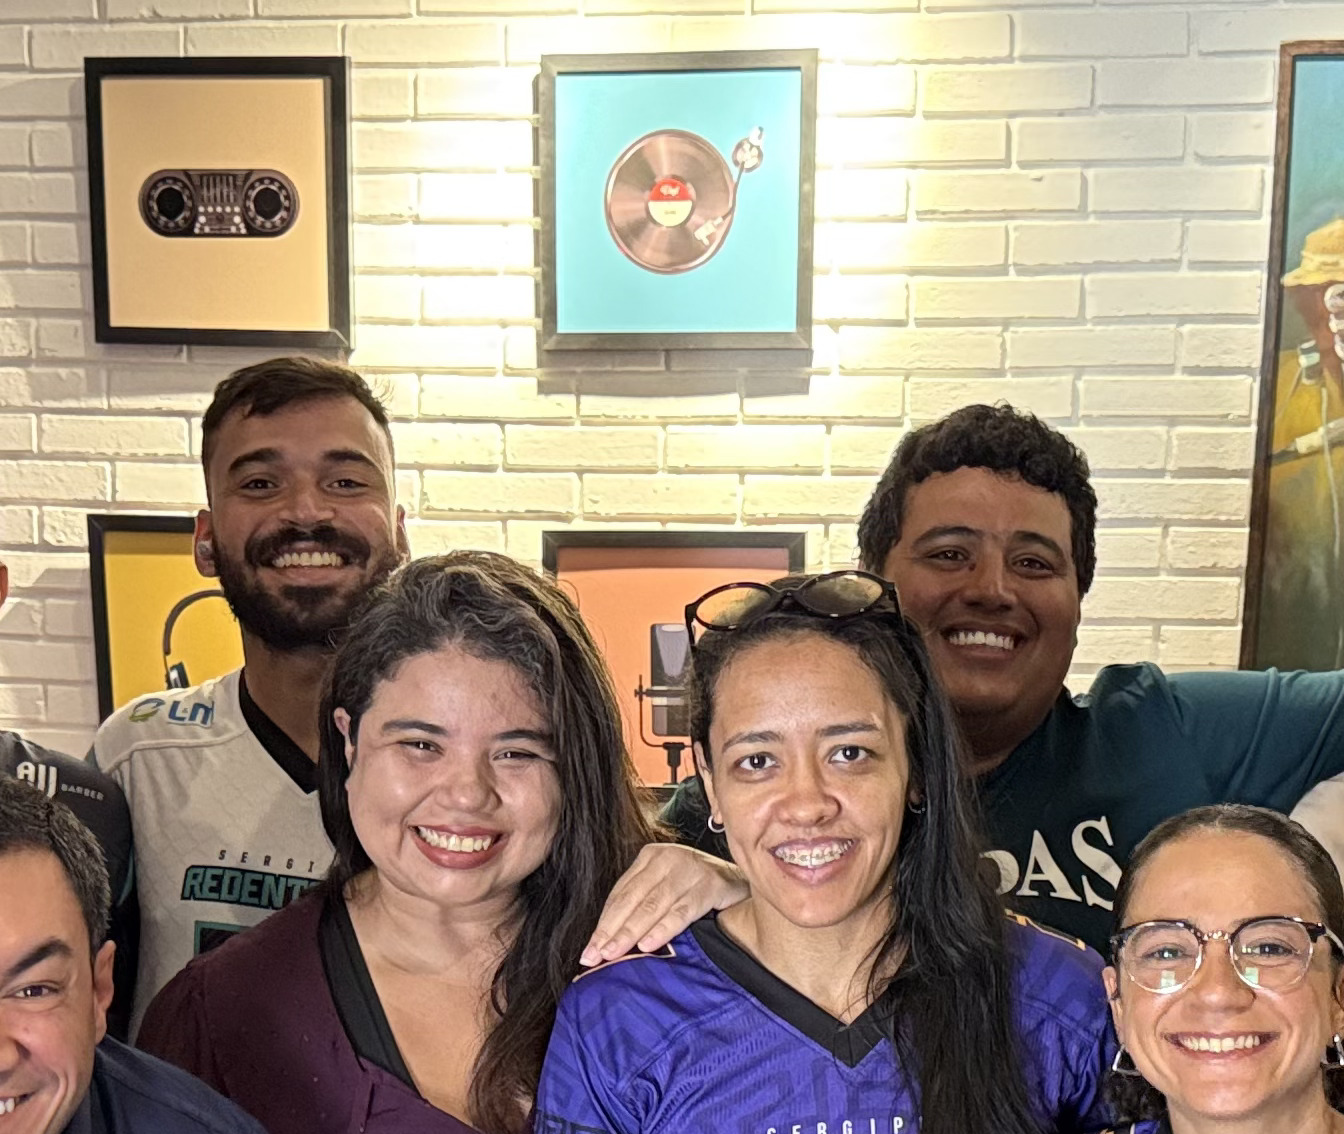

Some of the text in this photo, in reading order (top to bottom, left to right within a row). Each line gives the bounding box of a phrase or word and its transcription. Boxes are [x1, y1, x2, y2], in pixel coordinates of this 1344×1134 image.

[61, 783, 104, 800] BARBER
[218, 850, 314, 873] SERGI
[181, 866, 324, 910] REDENT
